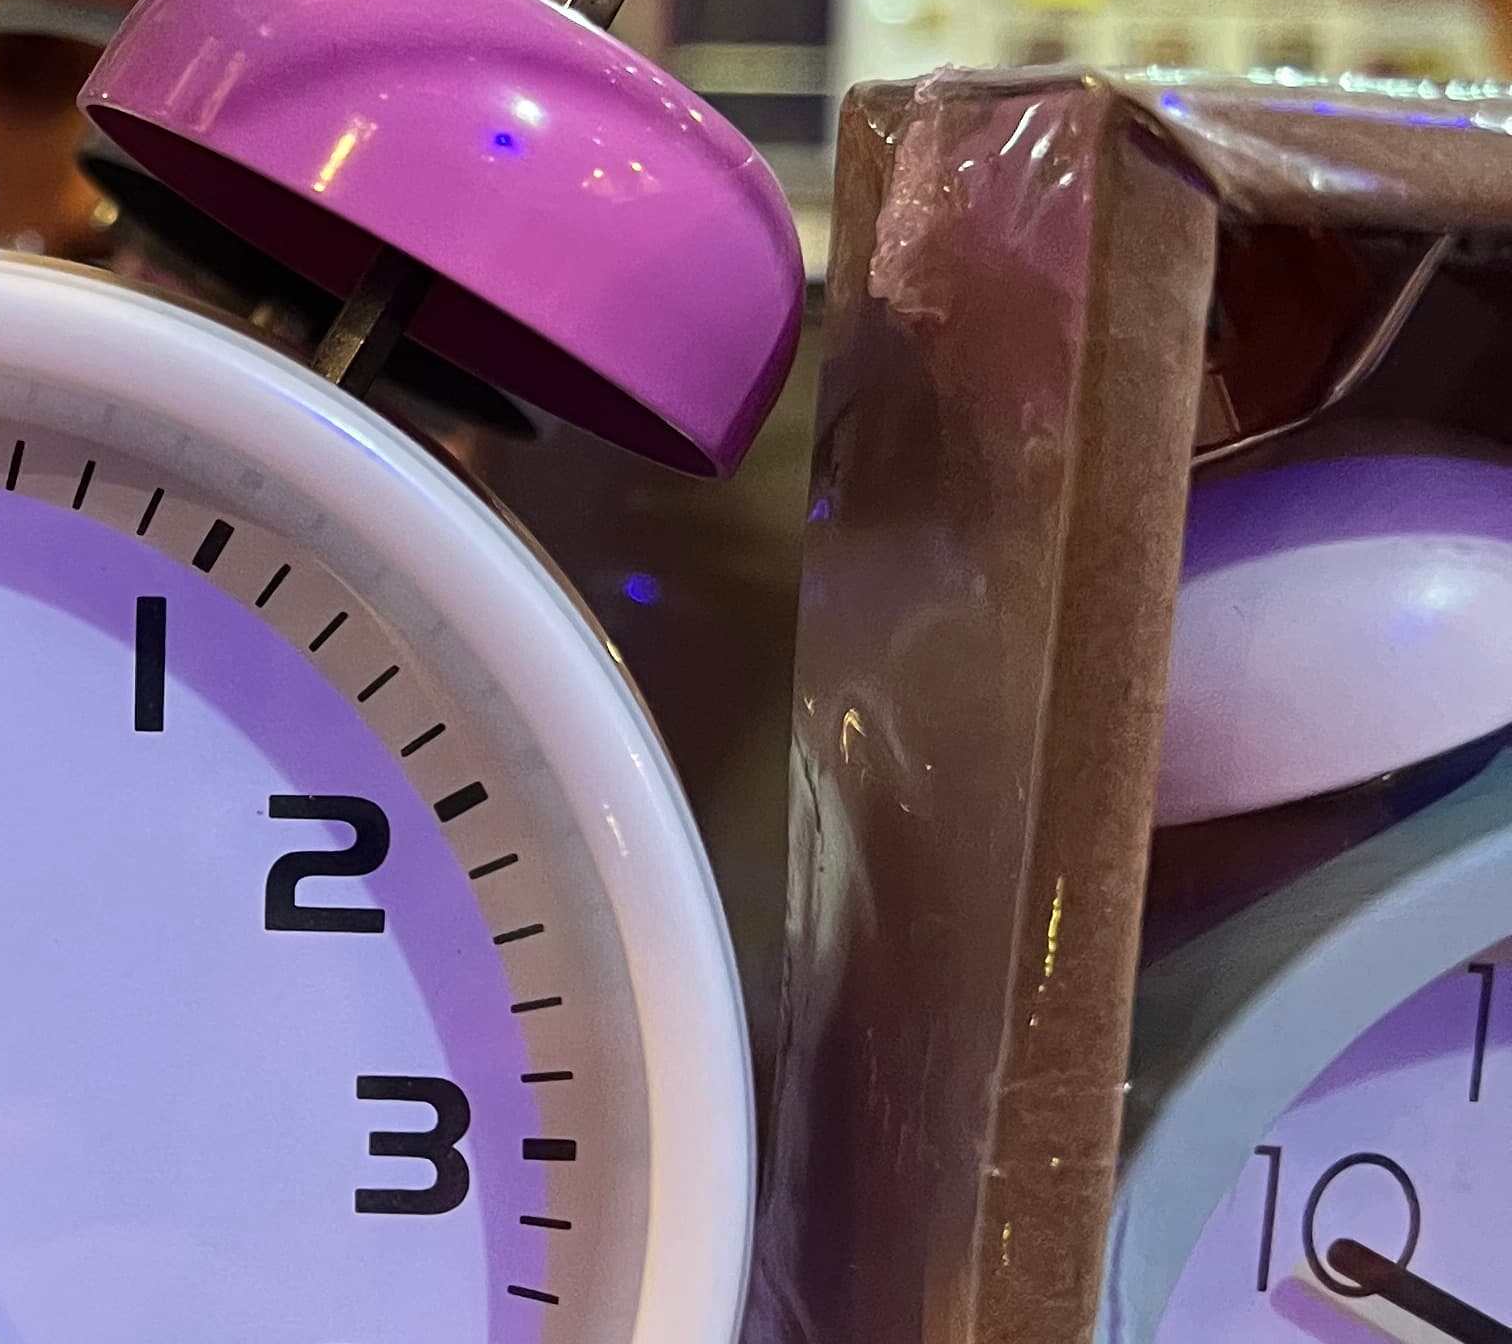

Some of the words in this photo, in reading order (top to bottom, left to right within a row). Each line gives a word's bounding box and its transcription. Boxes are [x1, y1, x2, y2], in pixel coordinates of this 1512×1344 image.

[134, 595, 168, 733] 1
[264, 794, 391, 934] 2
[354, 1075, 472, 1216] 3
[1254, 1144, 1421, 1298] 10
